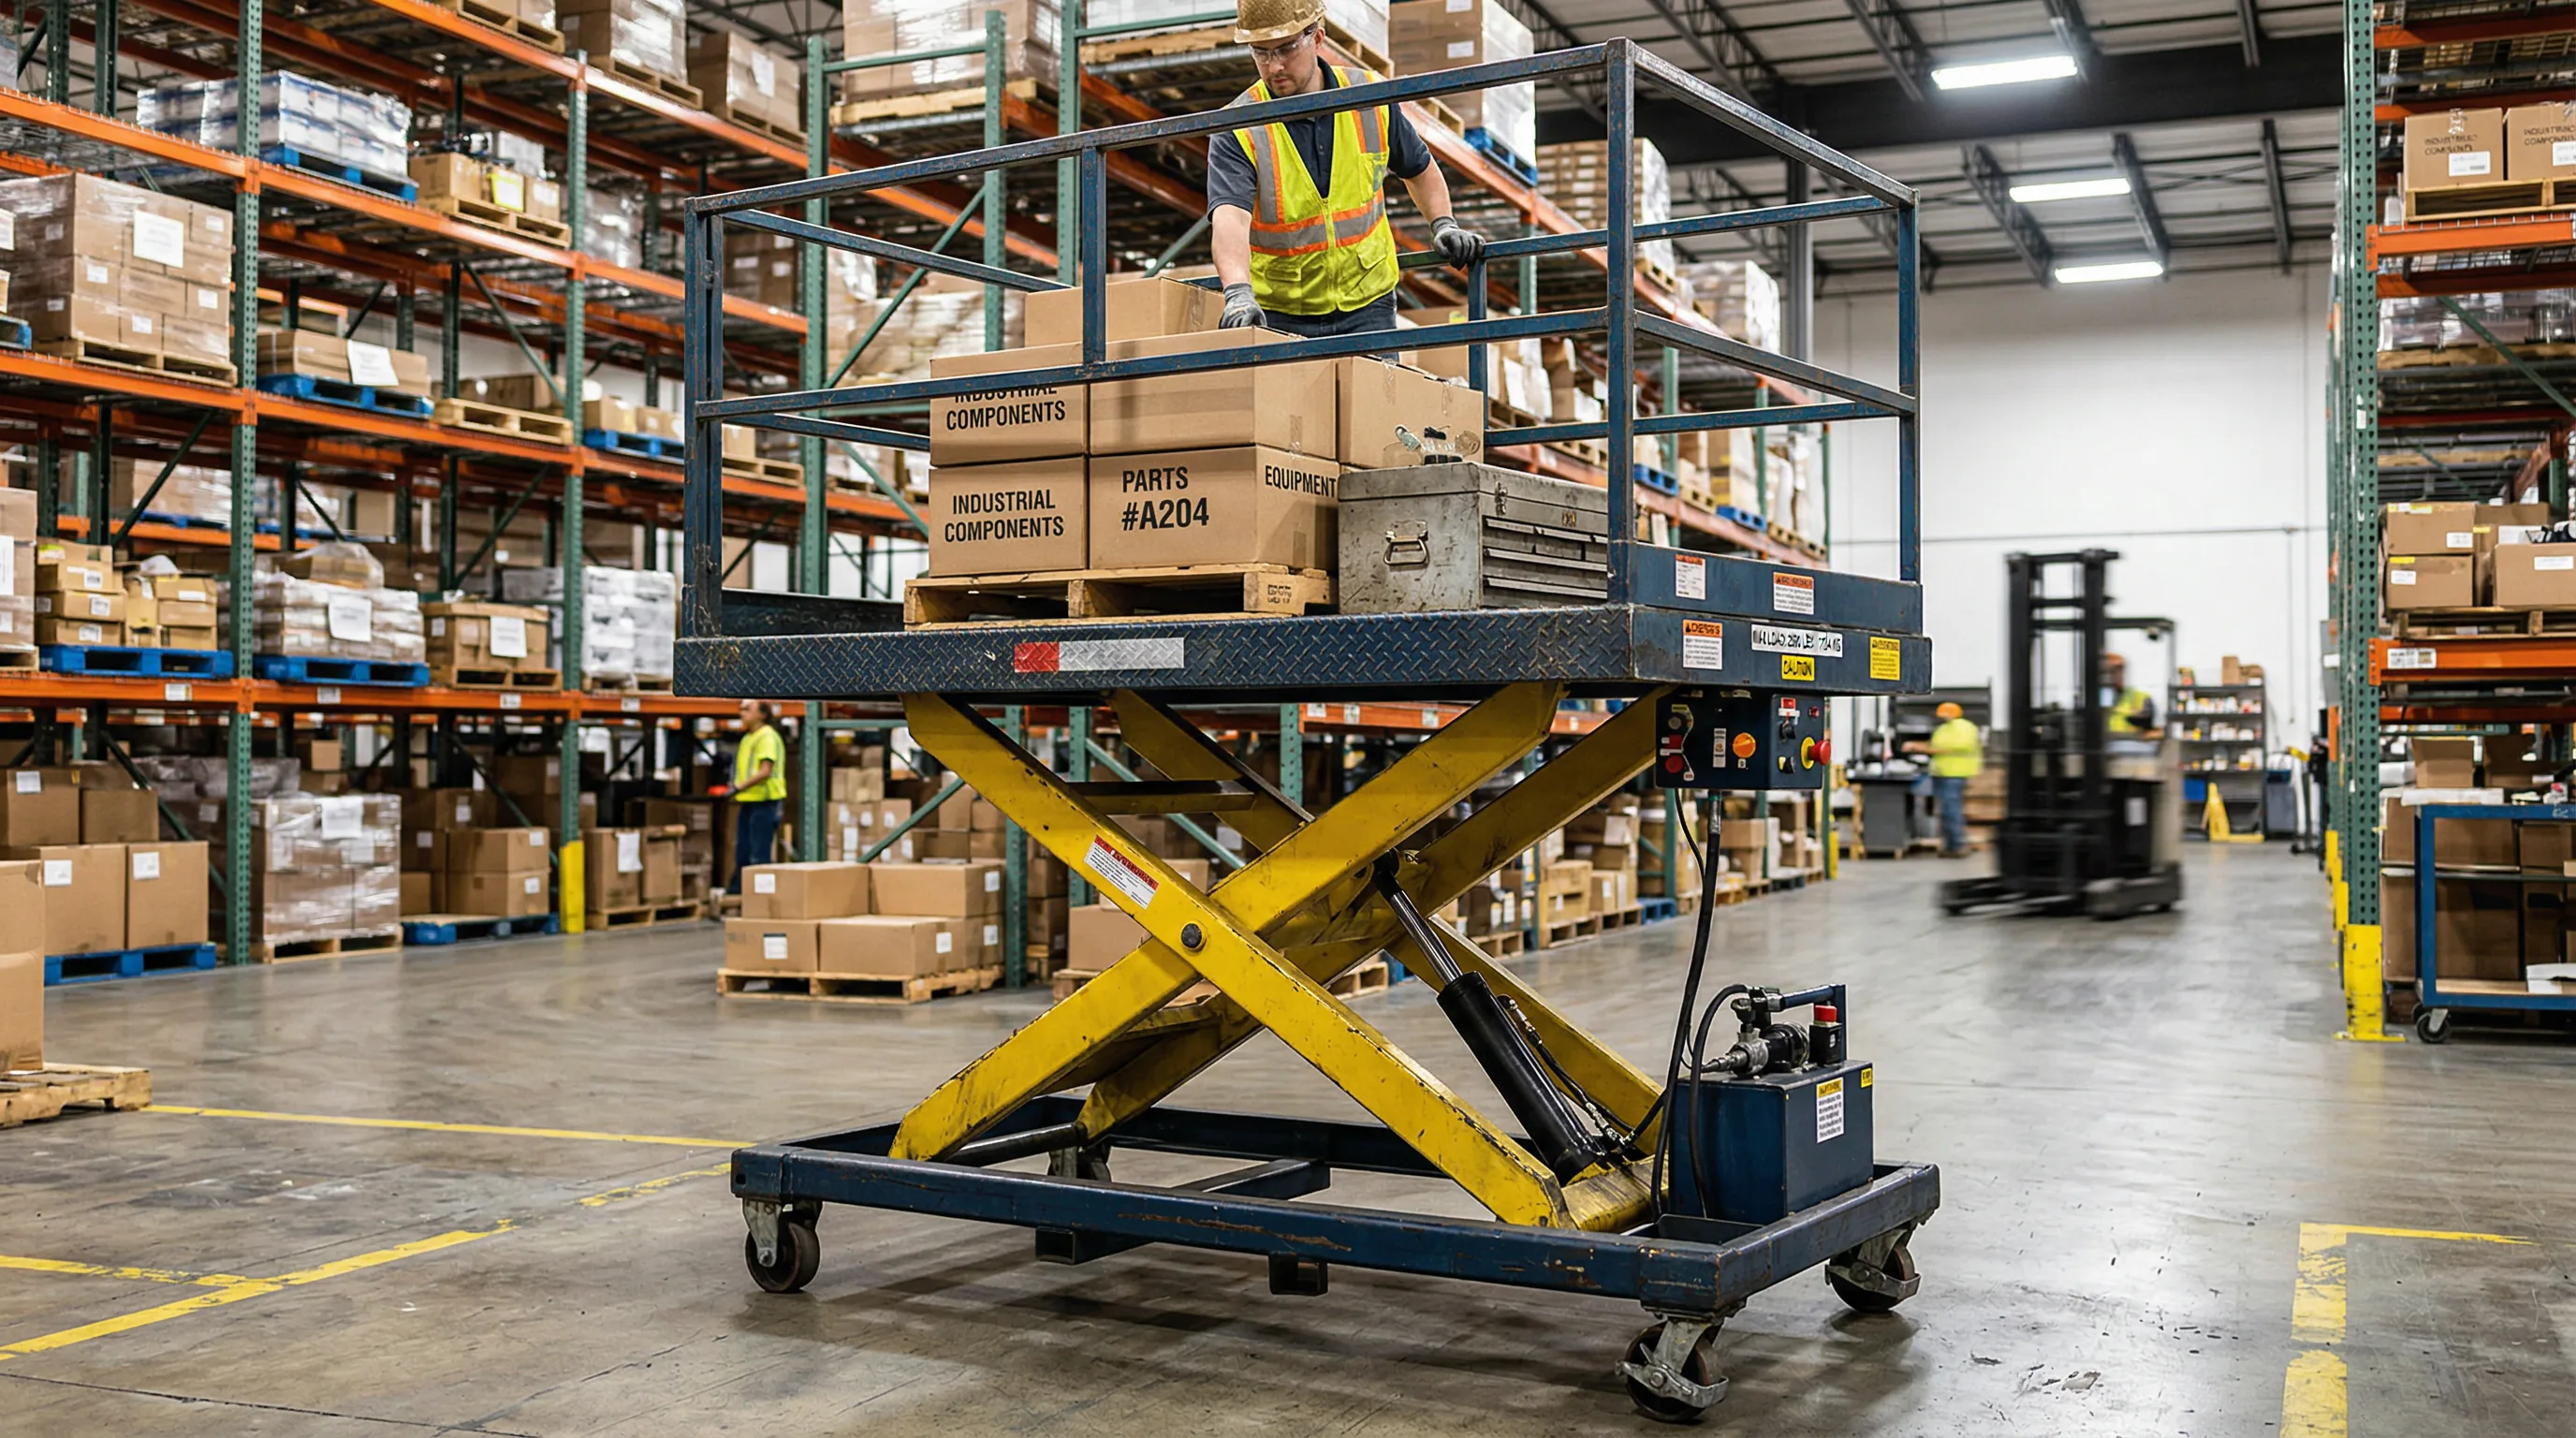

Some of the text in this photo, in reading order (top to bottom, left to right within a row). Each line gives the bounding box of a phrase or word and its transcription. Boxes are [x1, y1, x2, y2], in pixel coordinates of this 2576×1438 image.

[946, 401, 1065, 431] COMPONENTS
[1122, 466, 1189, 492] PARTS
[1266, 465, 1337, 498] EQUIPMENT
[953, 490, 1056, 515] INDUSTRIAL
[1121, 497, 1209, 531] #A204
[944, 516, 1064, 543] COMPONENTS
